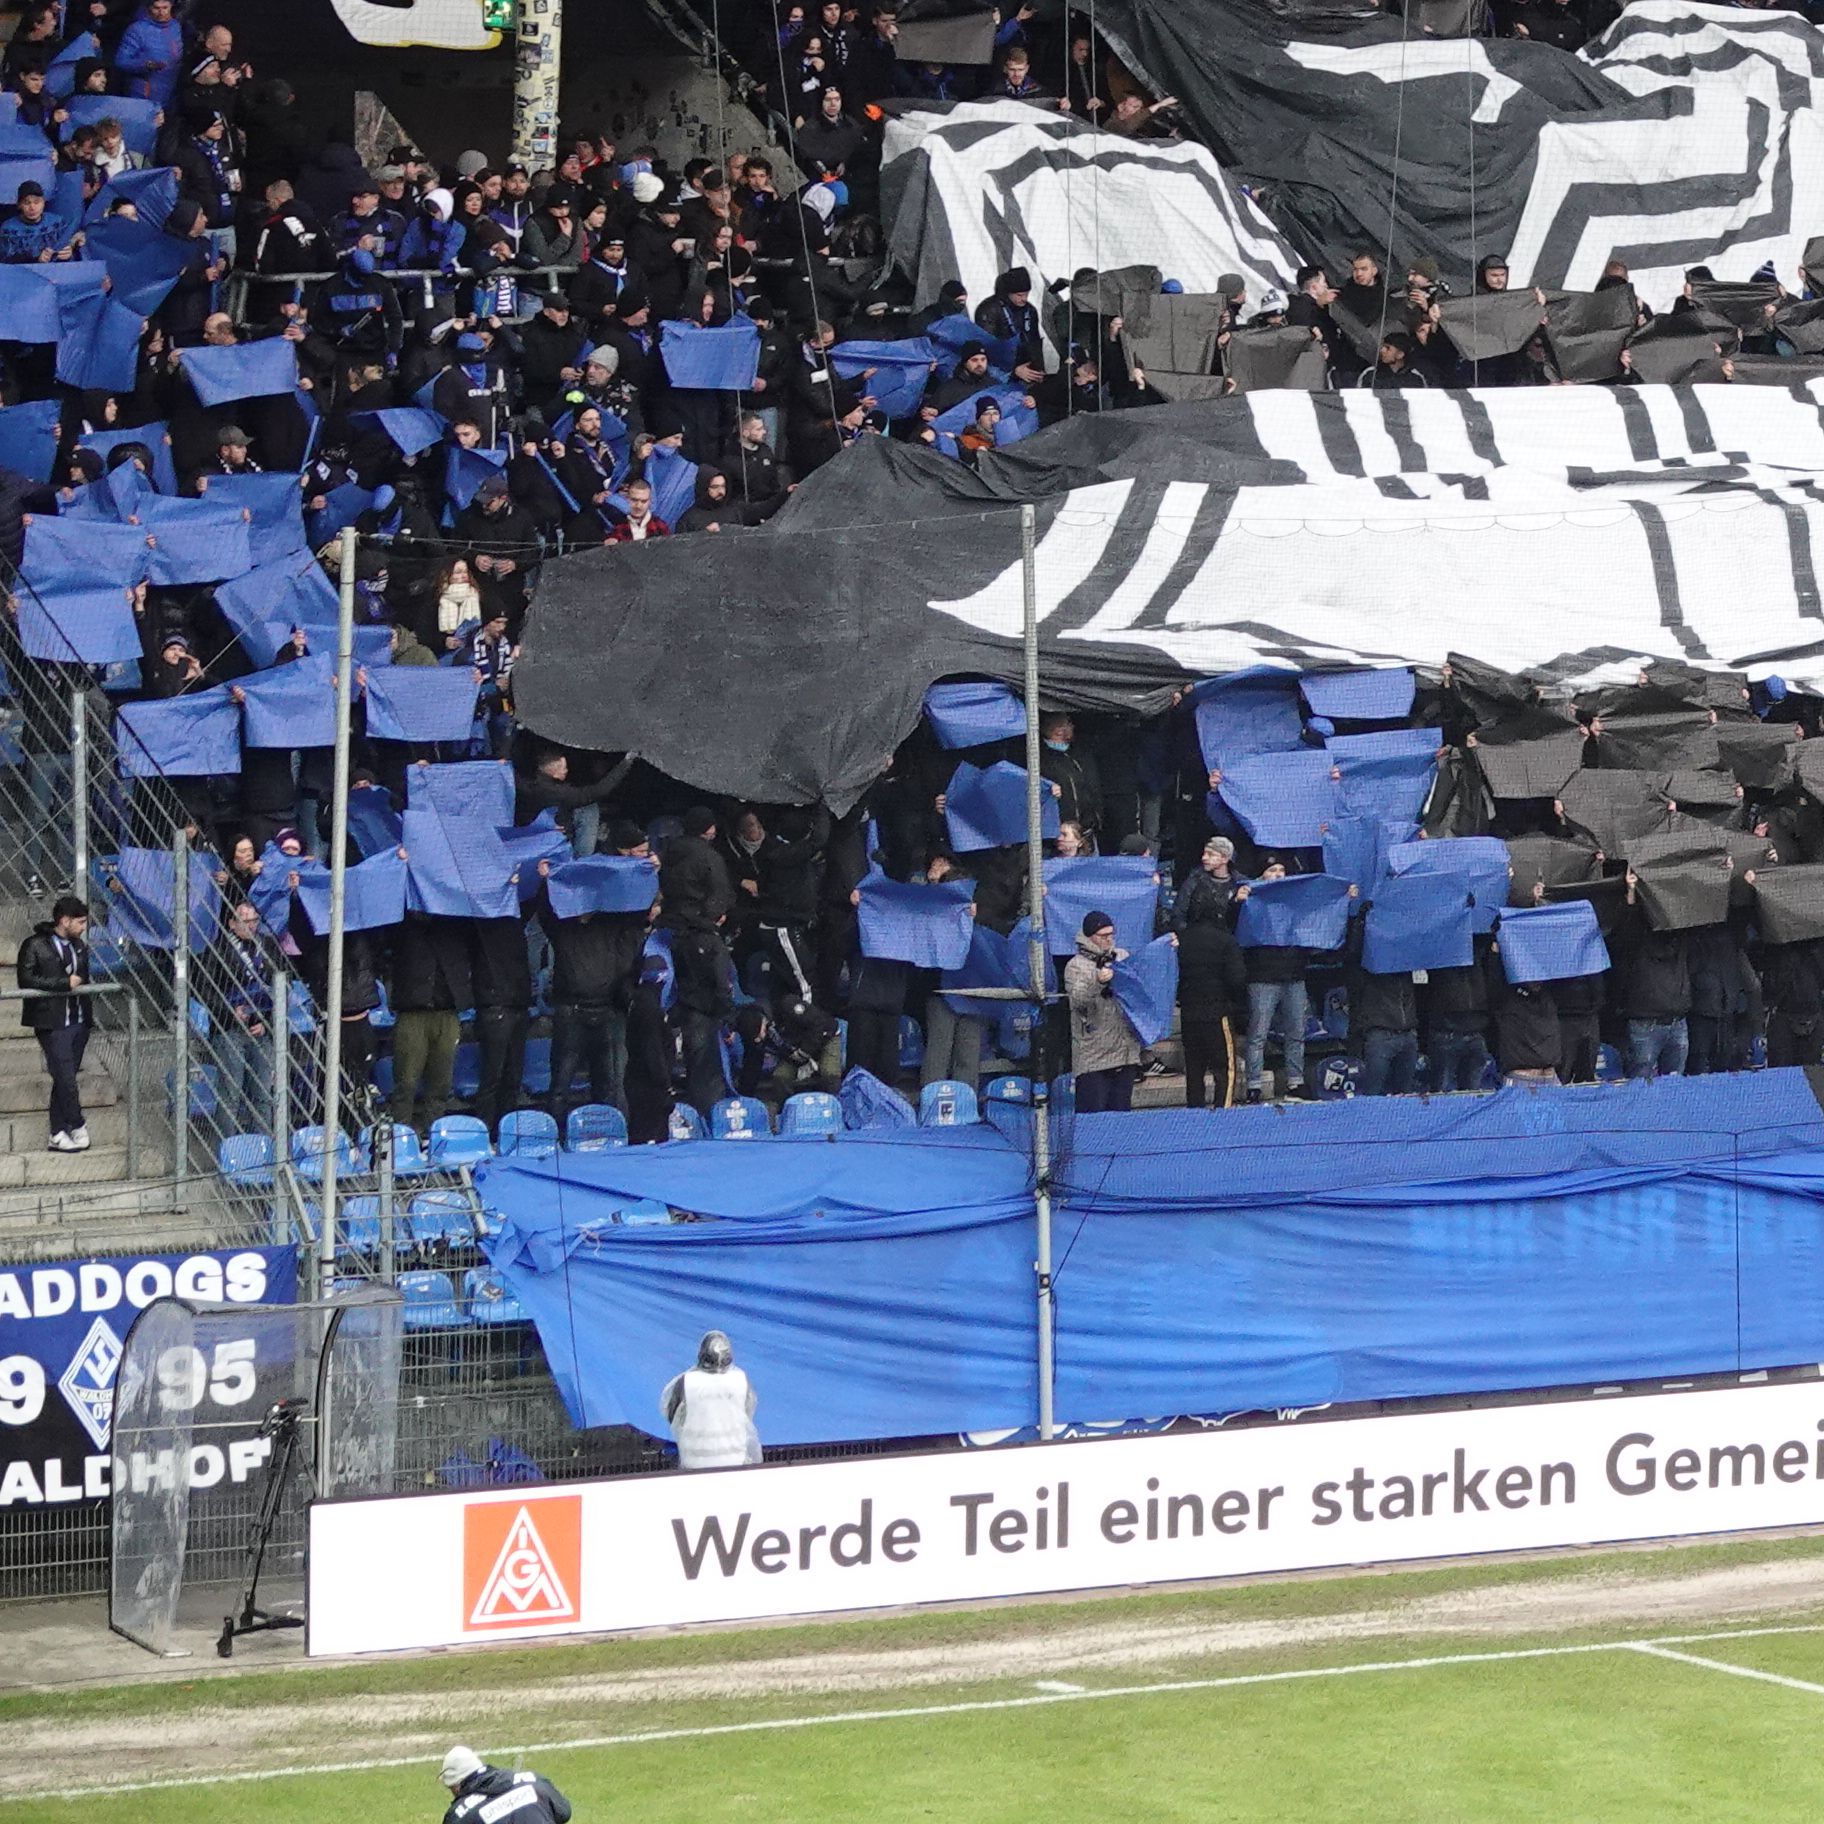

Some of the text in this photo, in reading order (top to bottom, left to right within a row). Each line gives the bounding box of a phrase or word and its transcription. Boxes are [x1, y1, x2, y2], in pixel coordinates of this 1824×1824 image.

[672, 1498, 921, 1580] Werde
[950, 1482, 1069, 1556] Teil
[1100, 1486, 1284, 1544] einer
[1312, 1448, 1576, 1525] starken
